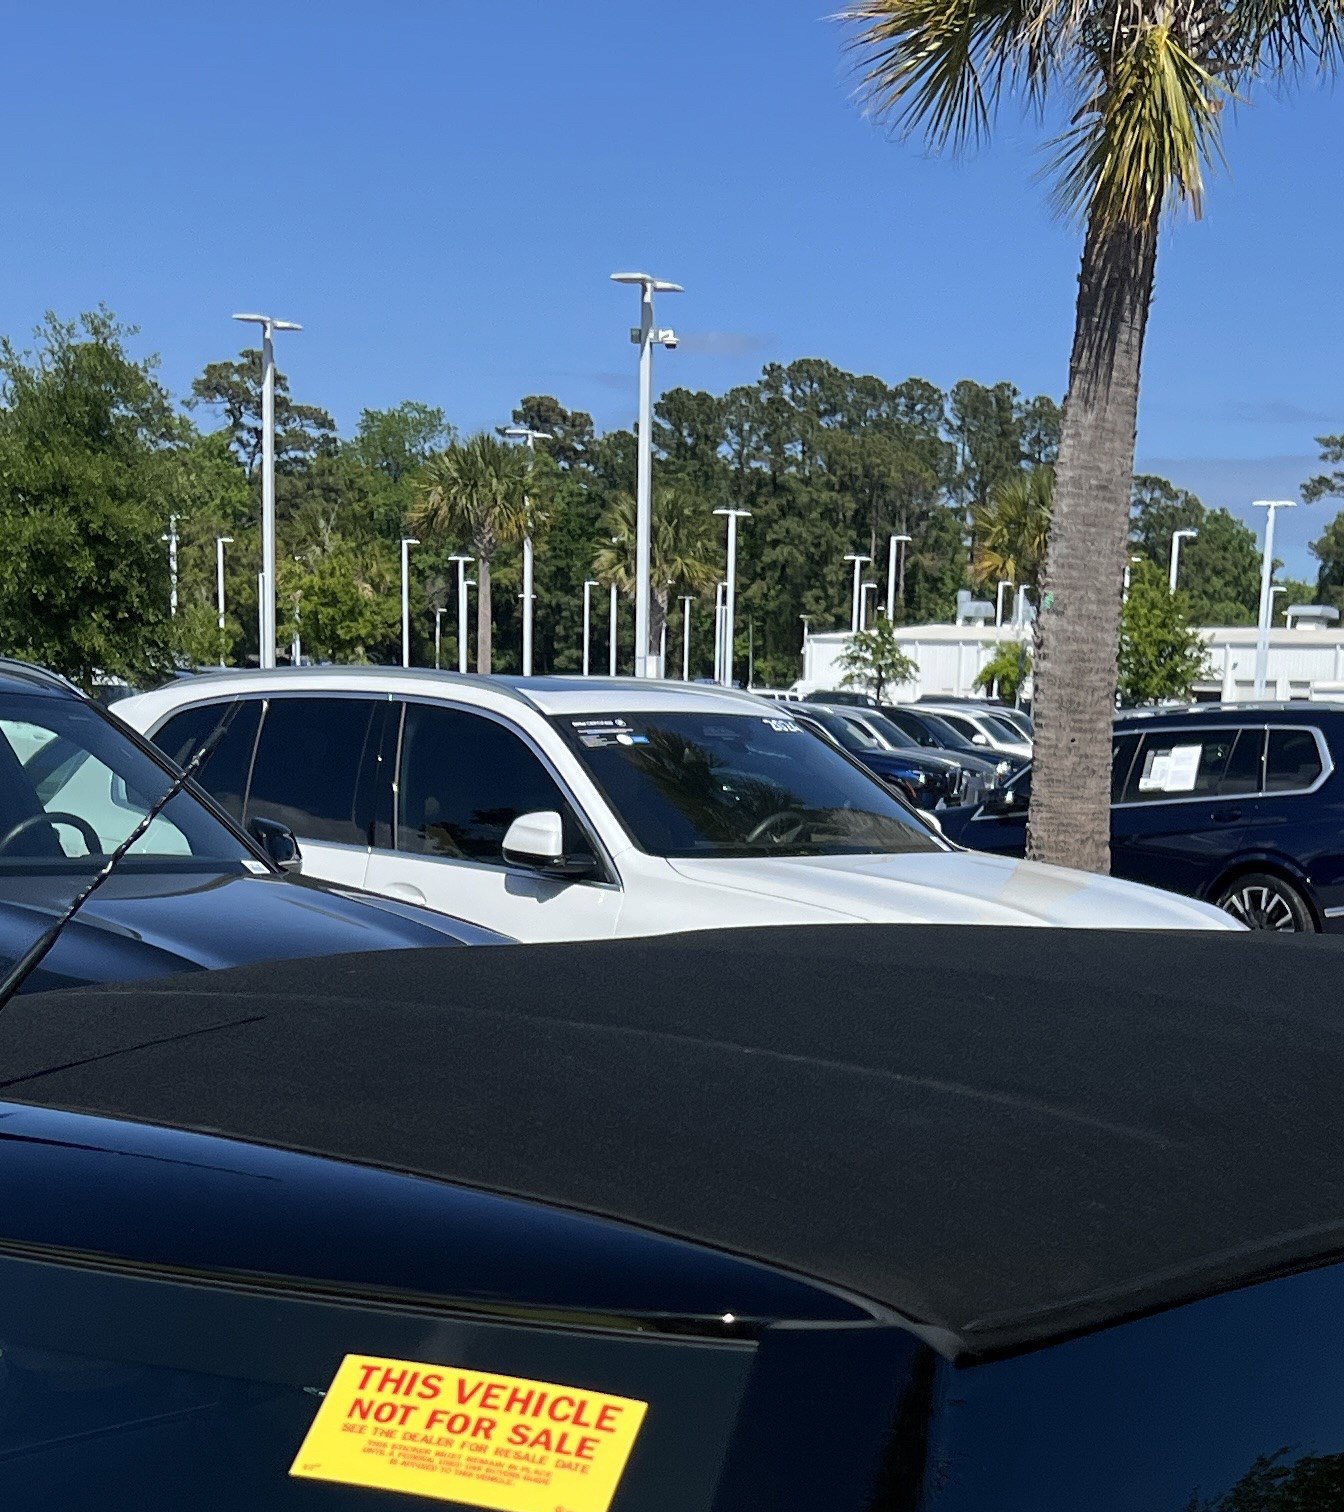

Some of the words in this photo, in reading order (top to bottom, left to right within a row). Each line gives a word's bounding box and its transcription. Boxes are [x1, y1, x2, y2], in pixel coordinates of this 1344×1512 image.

[348, 1398, 417, 1427] NOT
[425, 1409, 497, 1440] FOR
[507, 1423, 600, 1460] SALE
[357, 1365, 444, 1400] THIS
[456, 1378, 623, 1433] VEHICLE
[341, 1422, 368, 1434] SEE
[372, 1427, 398, 1439] THE
[401, 1431, 455, 1448] DEALER
[460, 1440, 489, 1454] FOR
[494, 1446, 548, 1466] RESALE
[554, 1459, 591, 1474] DATE
